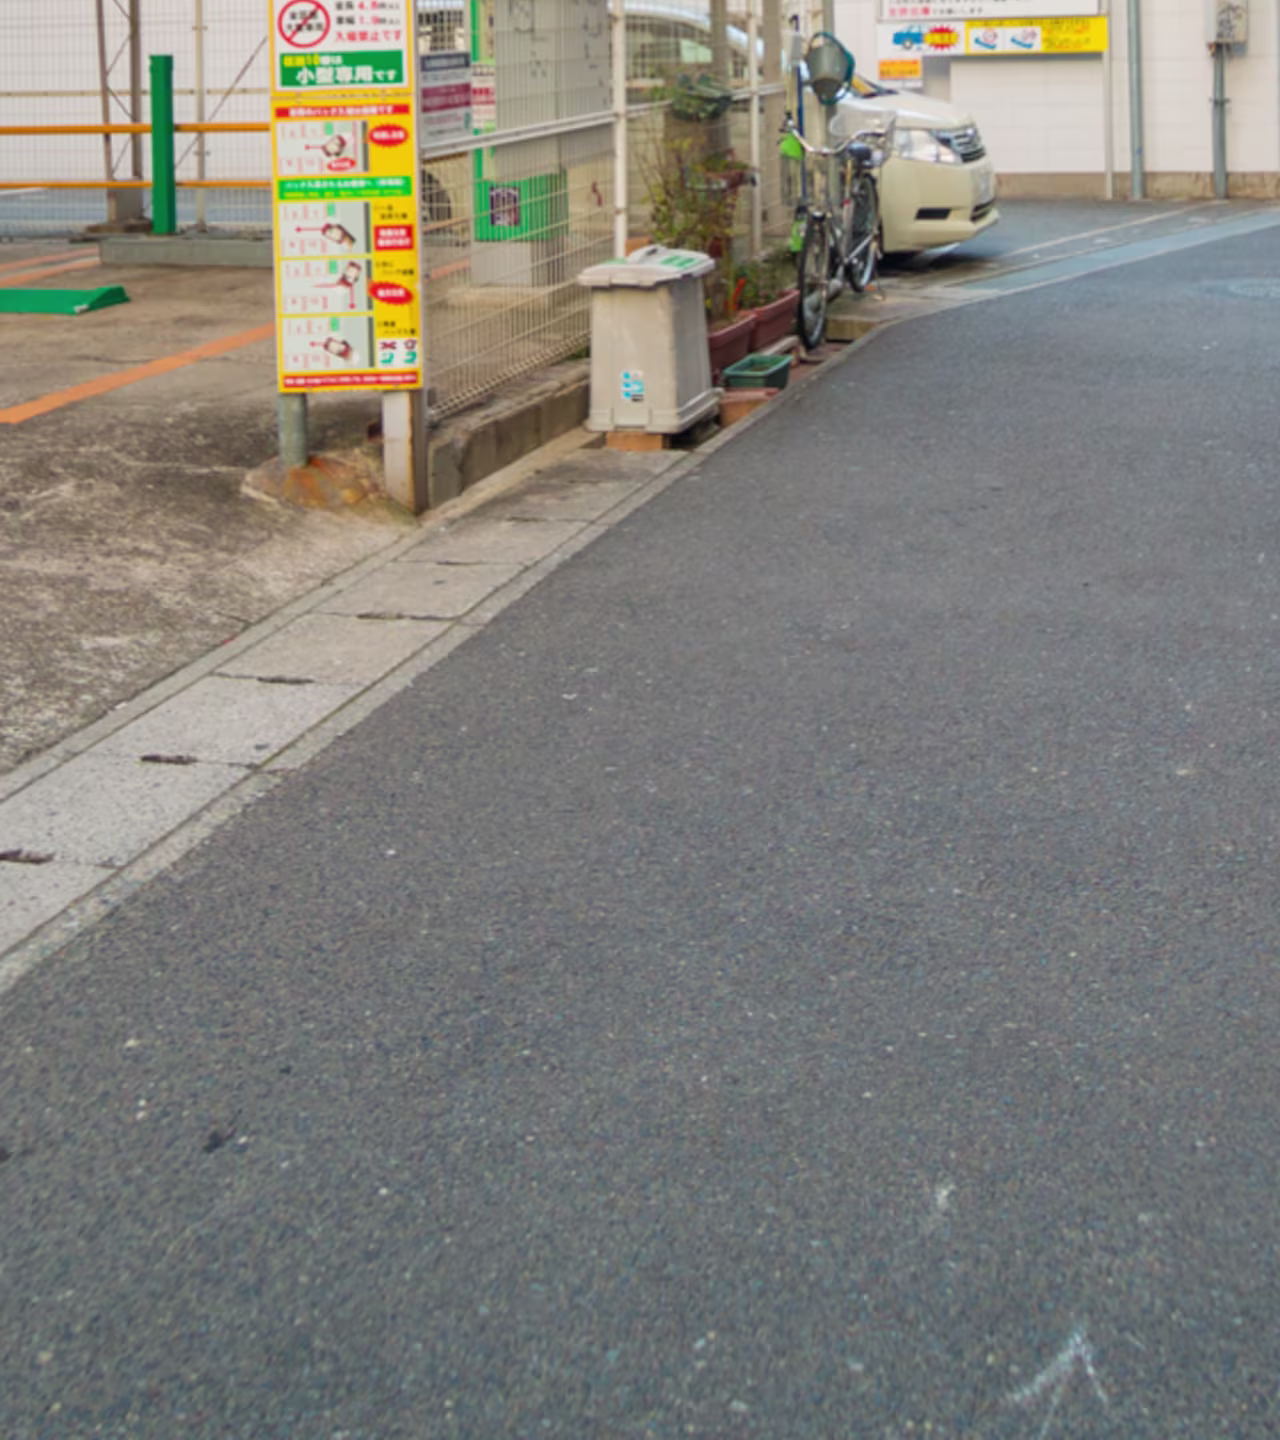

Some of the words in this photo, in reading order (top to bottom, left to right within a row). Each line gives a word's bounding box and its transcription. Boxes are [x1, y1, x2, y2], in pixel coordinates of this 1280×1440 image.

[295, 64, 397, 85] 小型専用です
